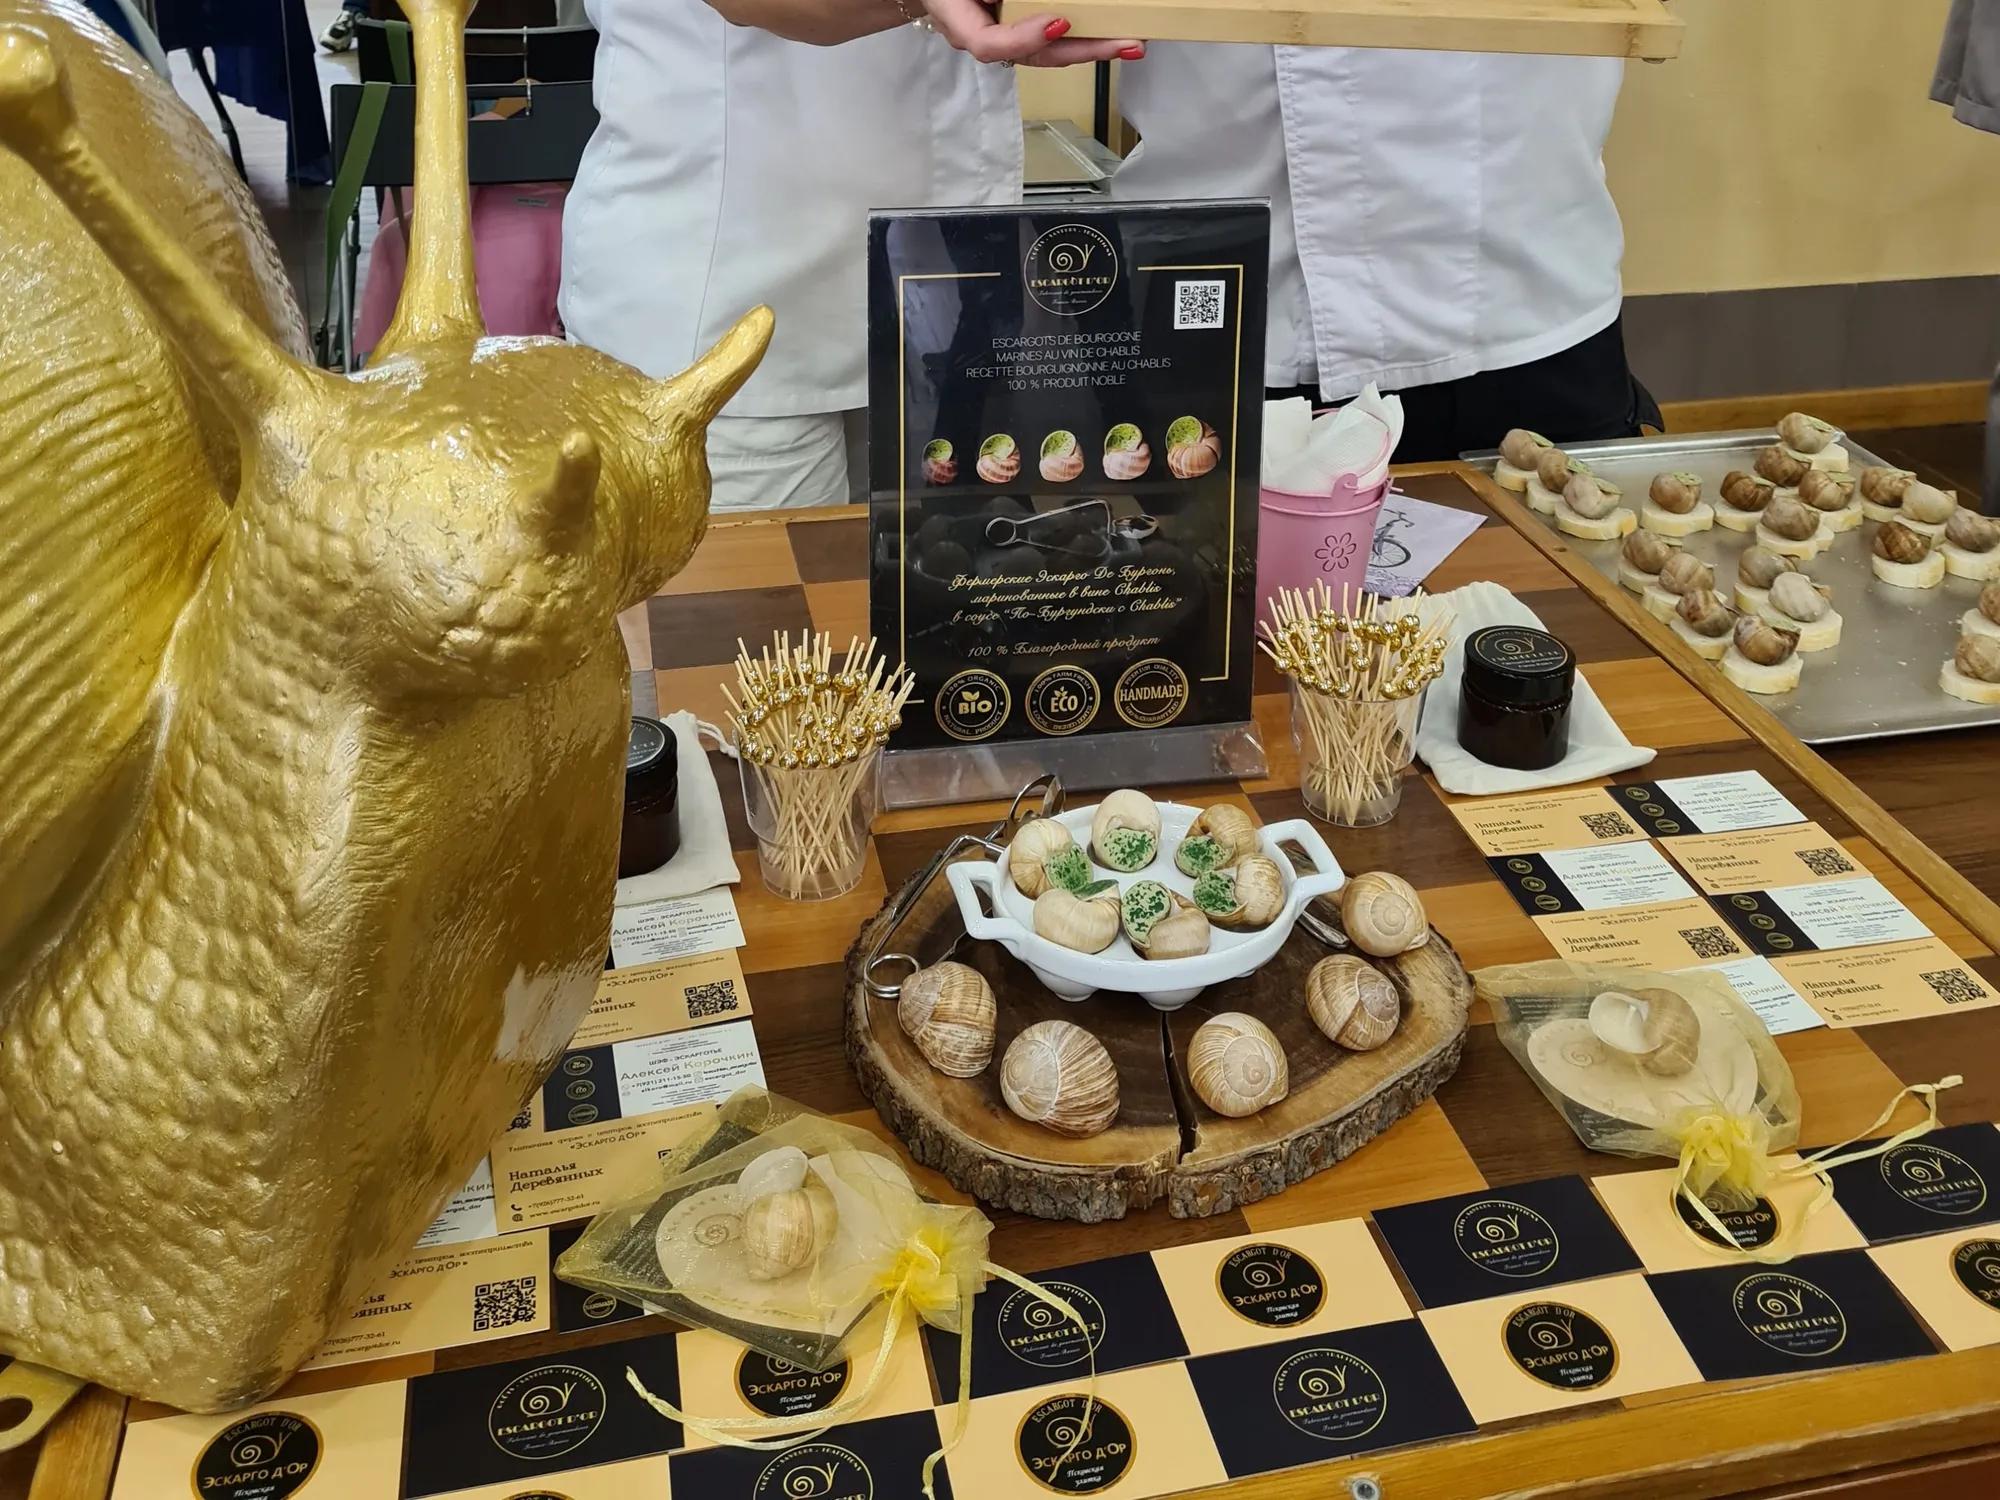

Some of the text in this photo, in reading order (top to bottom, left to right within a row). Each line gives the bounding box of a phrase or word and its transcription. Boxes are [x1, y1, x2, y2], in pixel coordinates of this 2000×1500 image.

[992, 331, 1142, 349] ESCARGOTS DE BOURGOGNE
[996, 345, 1141, 363] MARINES AU VIN DE CHABLIS
[966, 358, 1172, 378] RECETTE BOURGUIGNONNE AU CHABLIS
[1008, 374, 1126, 391] 100 % PRODUIT NOBLE
[948, 573, 1034, 592] Фермерские
[1035, 569, 1090, 586] Эскарго
[1093, 566, 1114, 580] Де
[970, 581, 1162, 607] маринованные в вине Chablis
[952, 609, 962, 625] в
[1117, 605, 1126, 613] с
[968, 635, 1161, 658] 100 % Благородный продукт
[1119, 684, 1184, 702] HANDMADE
[958, 700, 993, 715] BIO
[1050, 695, 1079, 713] ECO
[620, 1063, 680, 1081] Алексей
[683, 1051, 754, 1070] Корочкин
[509, 1162, 577, 1182] Наталья
[510, 1167, 604, 1194] Деревянных
[1691, 1216, 1743, 1230] ЭСРГО
[1232, 1290, 1287, 1307] ЭСКАРГО
[1522, 1351, 1579, 1369] ЭСКАРГО
[748, 1371, 842, 1397] ЭСКАРГО Д'ОР
[202, 1469, 270, 1490] ЭСКАРГО
